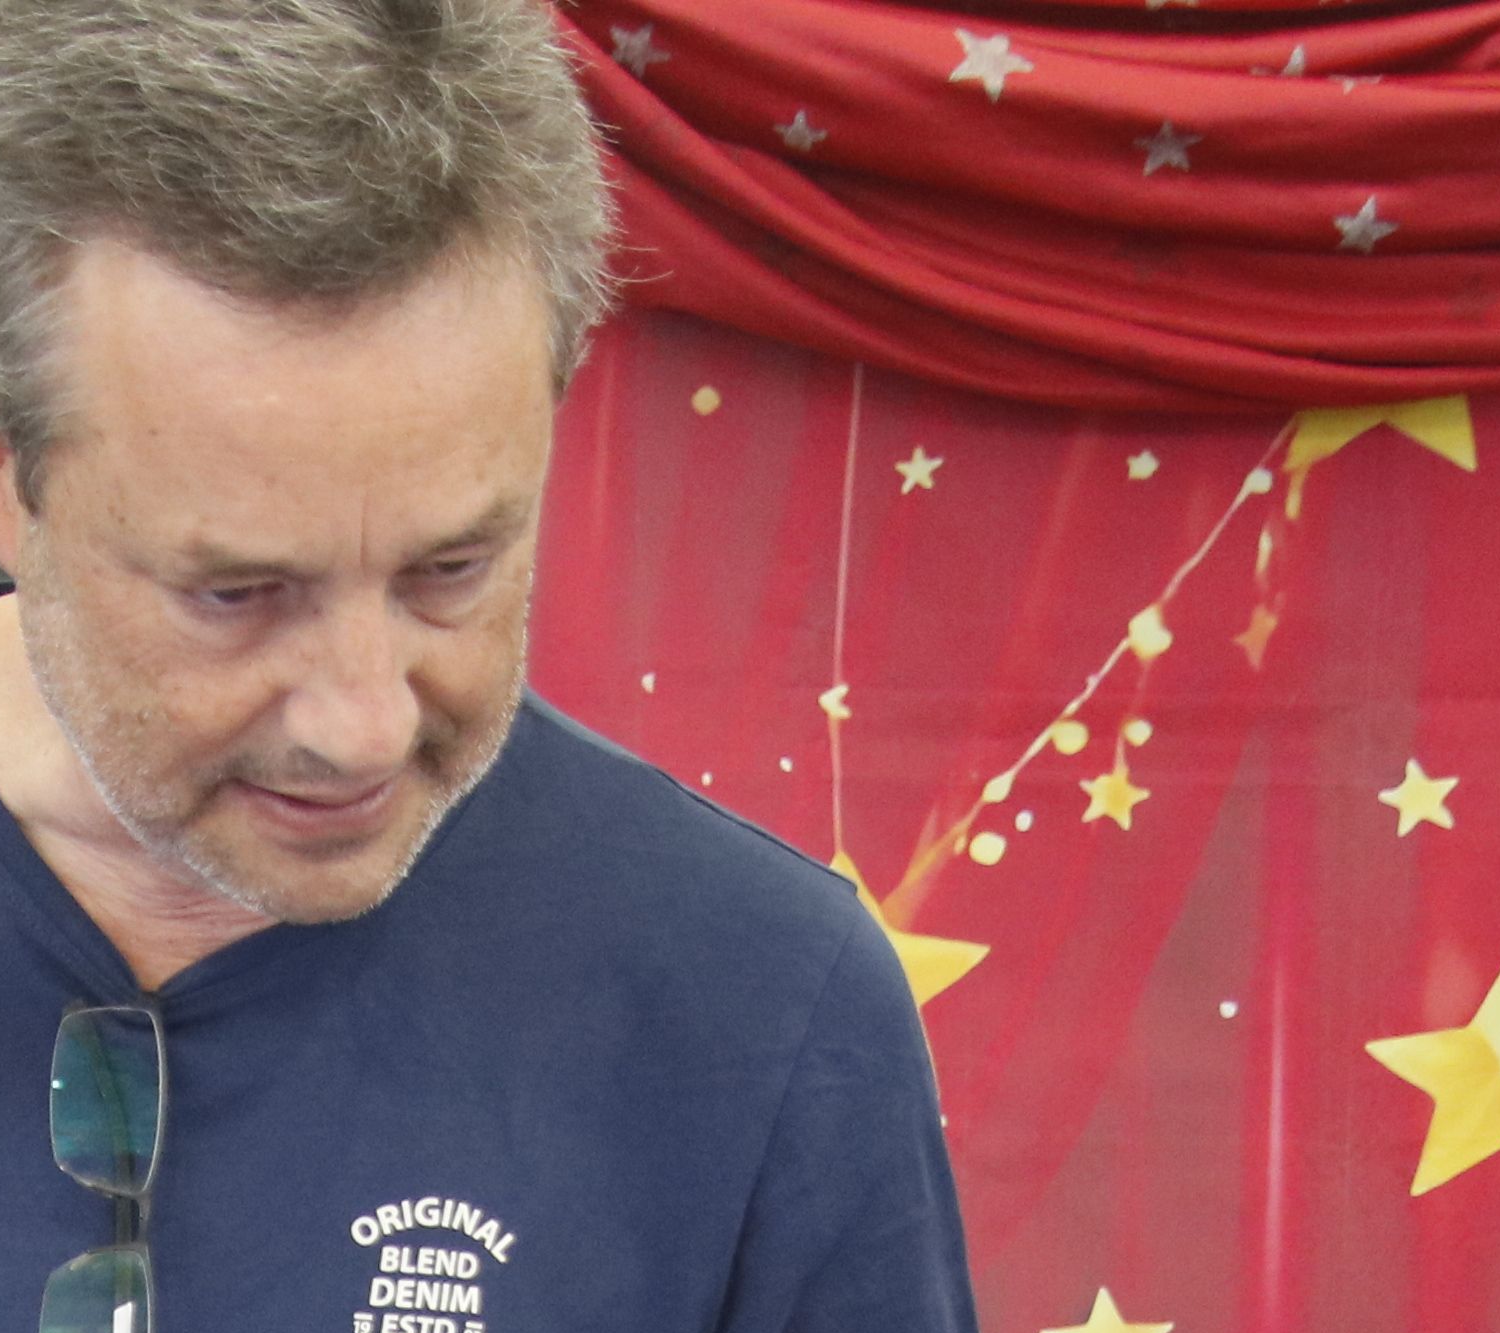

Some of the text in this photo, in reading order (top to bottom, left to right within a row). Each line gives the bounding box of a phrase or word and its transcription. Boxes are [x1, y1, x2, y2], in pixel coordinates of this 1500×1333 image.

[350, 1196, 515, 1264] ORIGINAL
[379, 1245, 480, 1280] BLEND
[368, 1276, 482, 1315] DENIM
